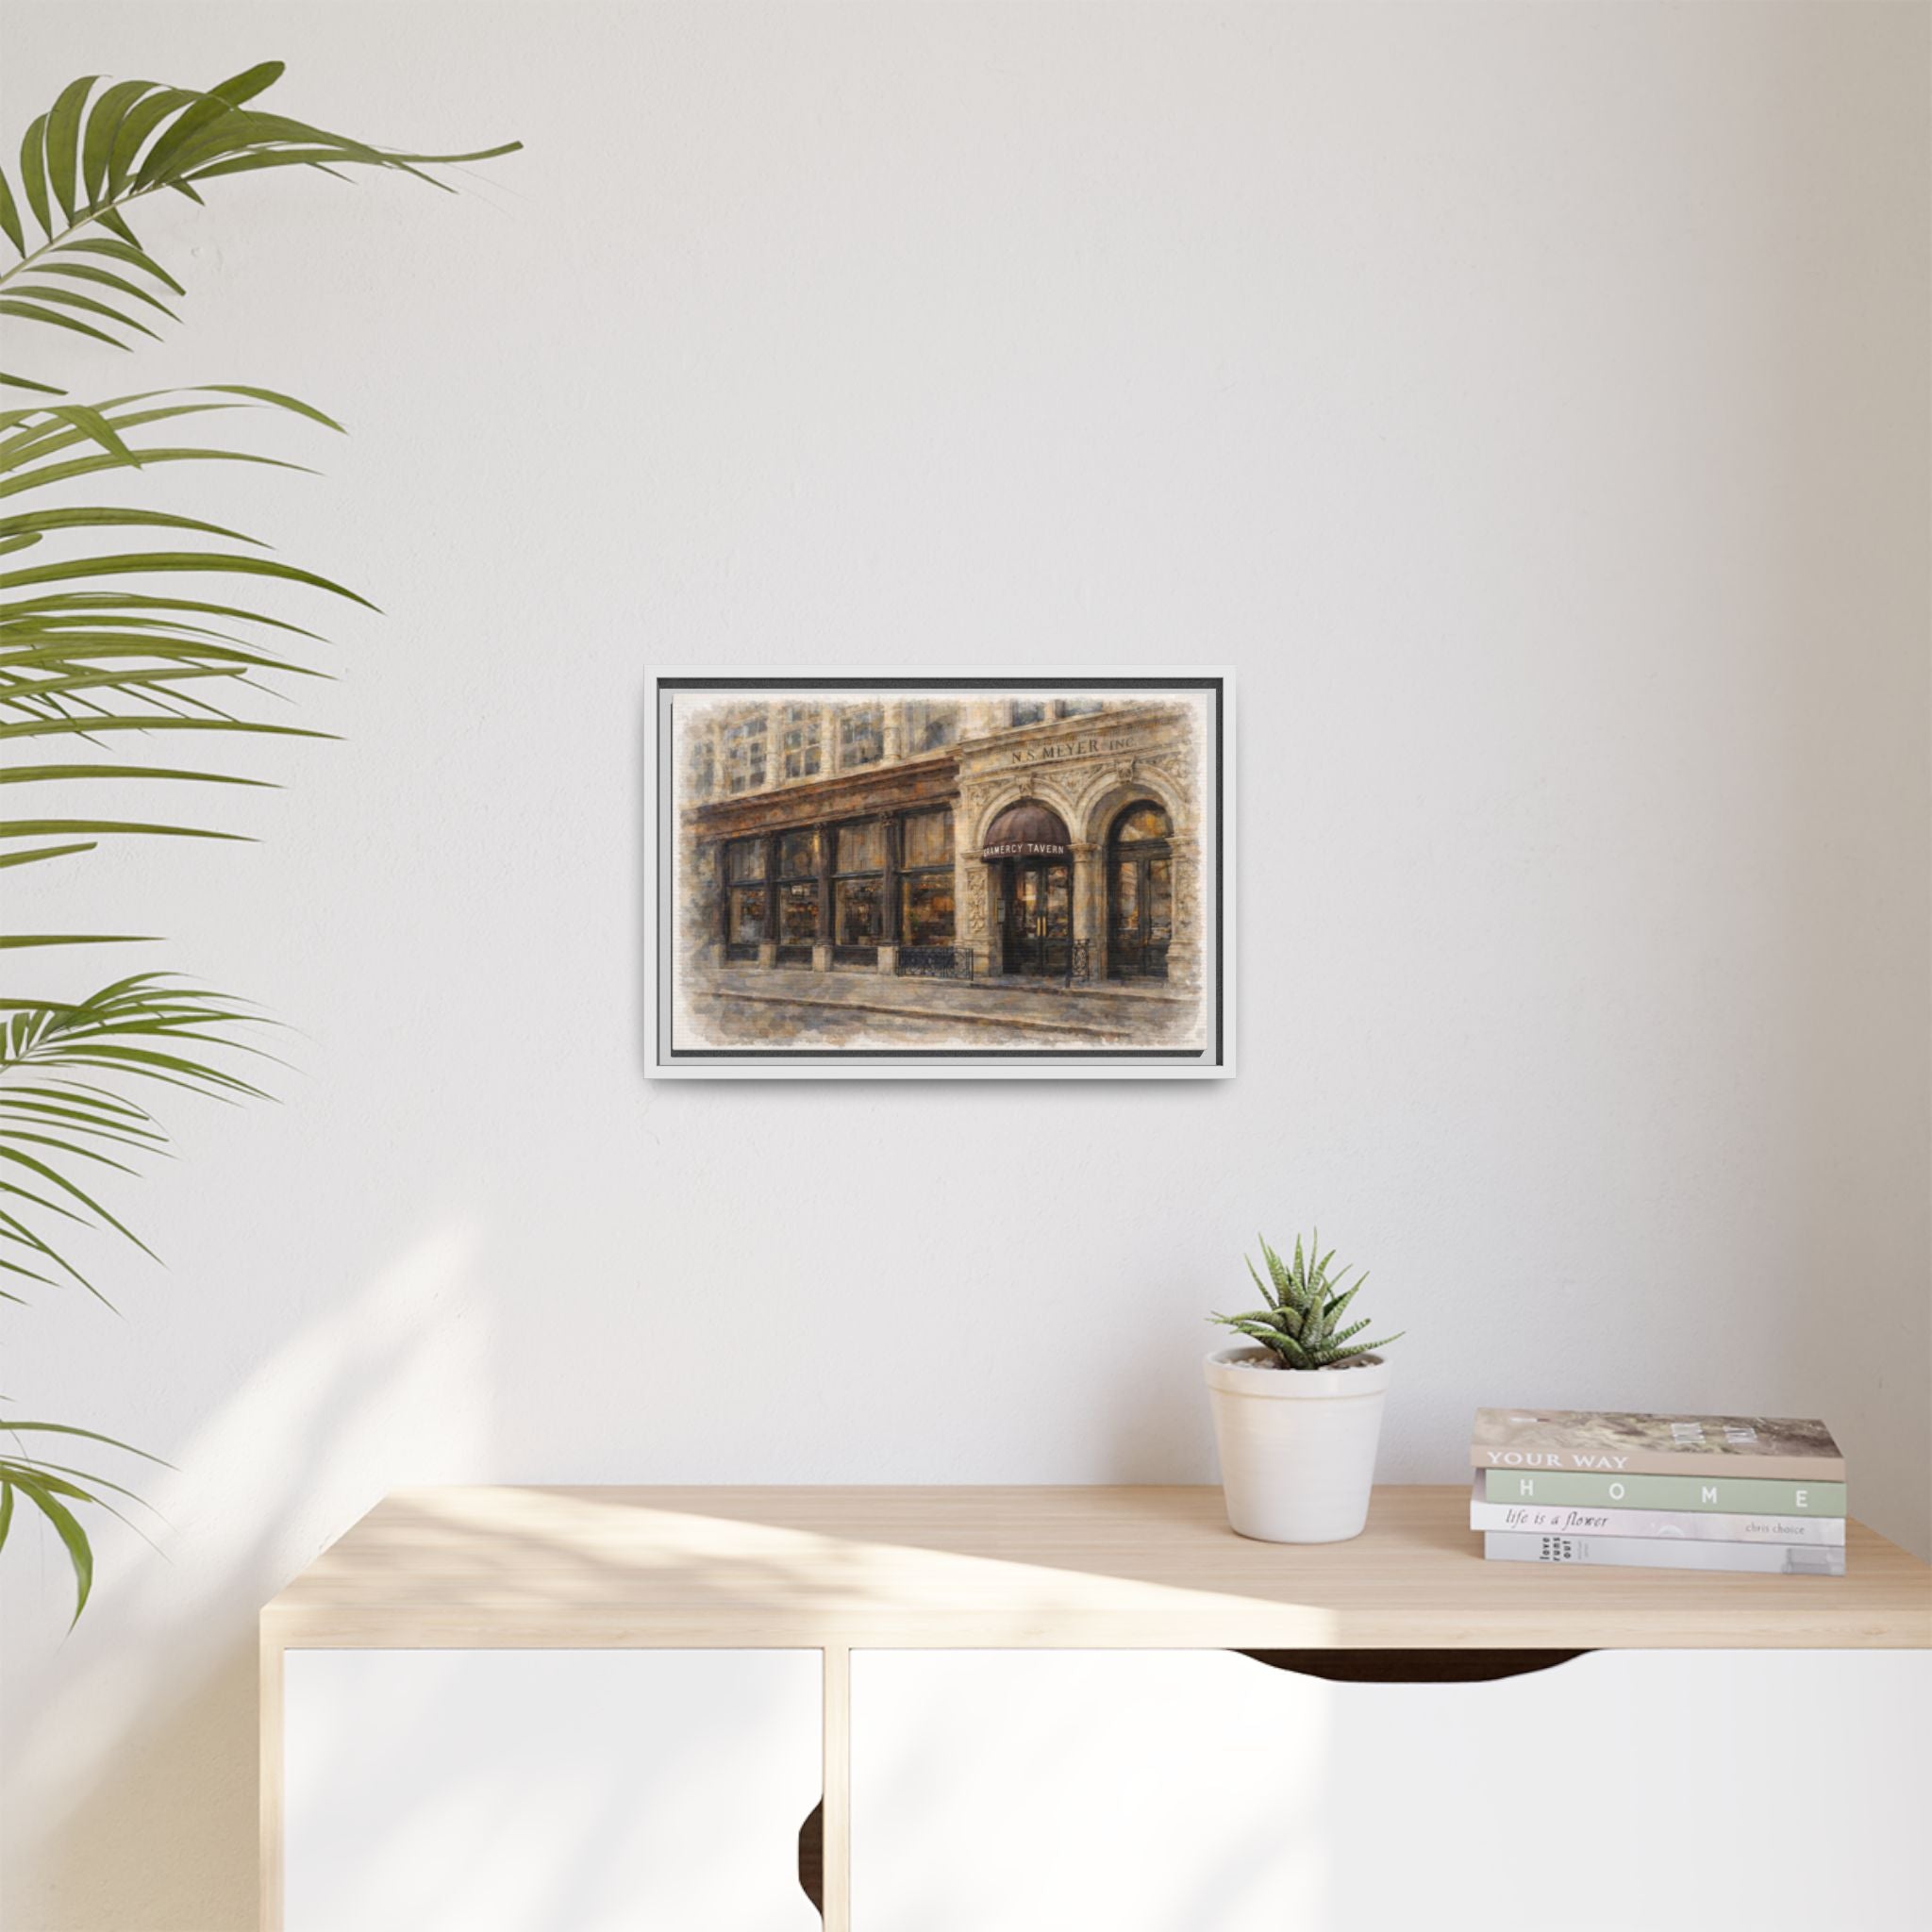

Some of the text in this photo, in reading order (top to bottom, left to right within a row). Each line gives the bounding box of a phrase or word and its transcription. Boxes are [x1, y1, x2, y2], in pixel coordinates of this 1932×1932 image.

[1042, 740, 1099, 758] MEYER
[1027, 843, 1064, 855] TAVERN
[1487, 1451, 1629, 1469] YOUR WAY
[1506, 1509, 1610, 1531] life is a flower
[1745, 1522, 1806, 1536] chris choice
[1539, 1537, 1550, 1560] love
[1552, 1537, 1561, 1561] runs
[1562, 1541, 1572, 1559] out
